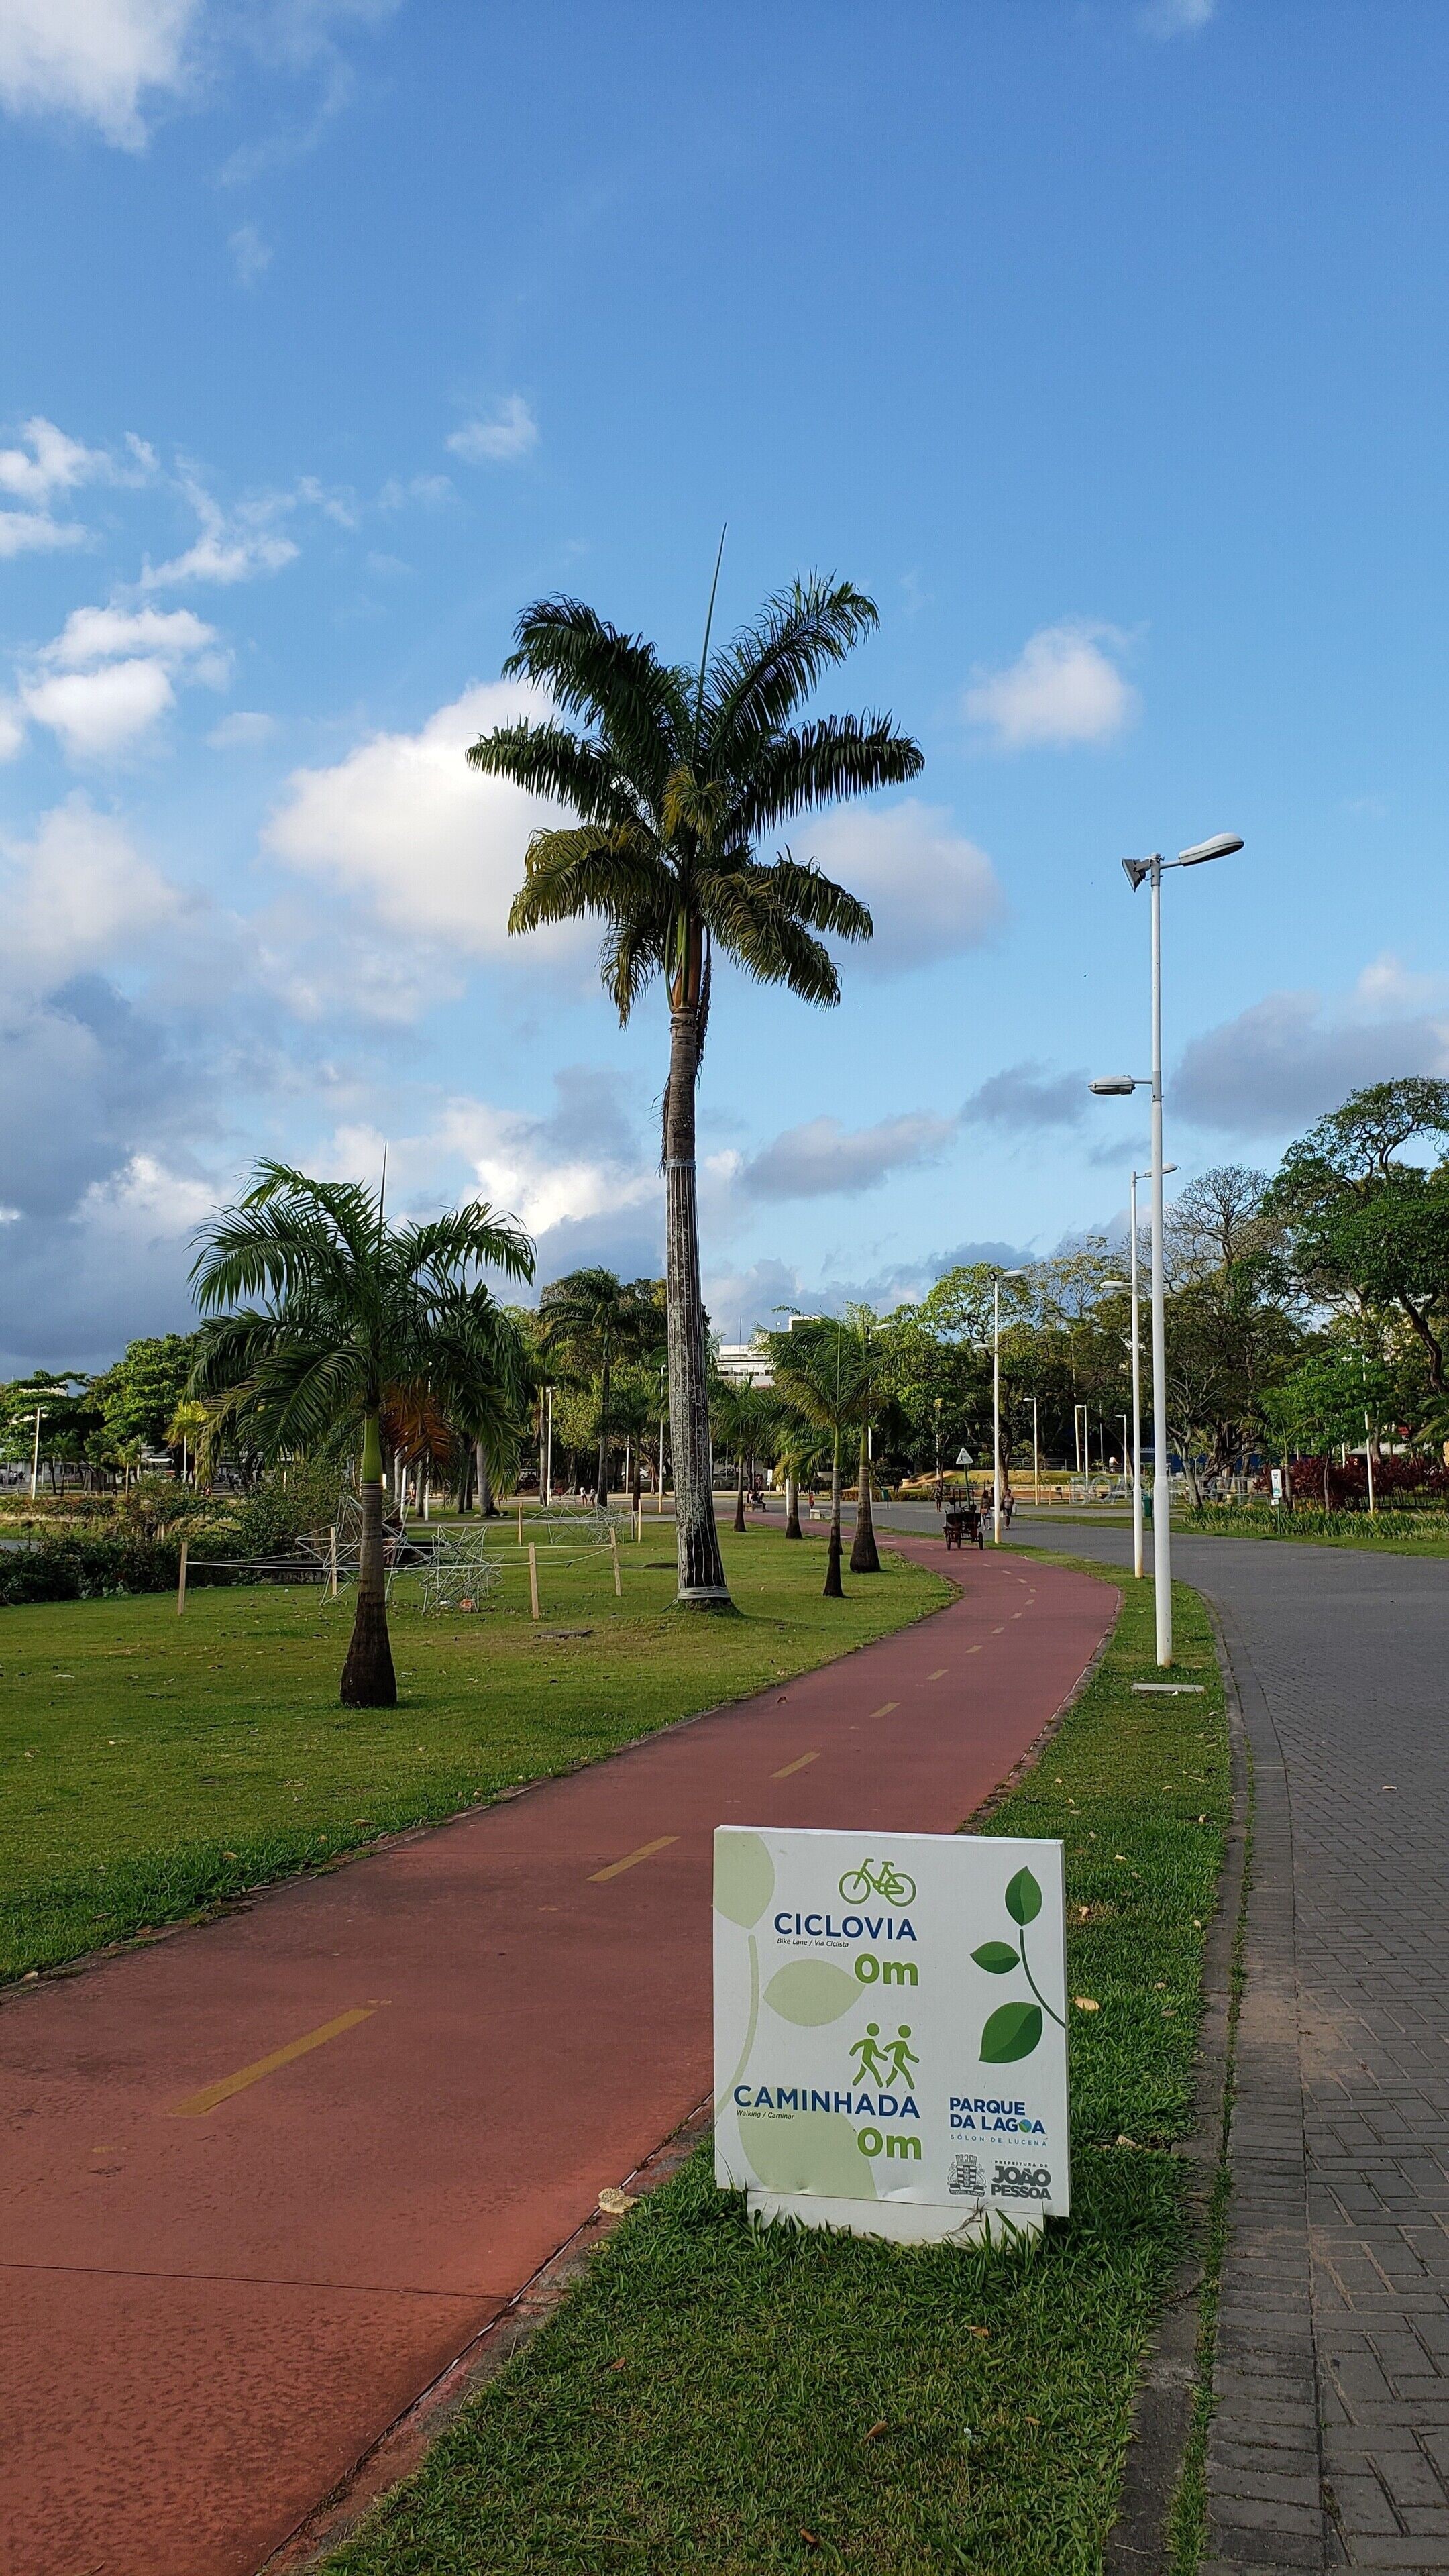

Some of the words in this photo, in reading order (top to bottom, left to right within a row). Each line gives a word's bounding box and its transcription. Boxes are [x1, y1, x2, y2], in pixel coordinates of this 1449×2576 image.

[774, 1912, 918, 1941] CICLOVIA
[777, 1937, 791, 1945] Bike
[792, 1938, 808, 1946] Lane
[826, 1940, 849, 1948] Ciclista
[854, 1953, 919, 1986] 0m
[733, 2084, 921, 2119] CAMINHADA
[949, 2096, 1026, 2116] PARQUE
[737, 2110, 761, 2119] Walking
[767, 2112, 795, 2121] Caminar
[950, 2114, 977, 2129] DA
[981, 2116, 1046, 2135] LAGOA
[857, 2127, 922, 2160] 0m
[1008, 2139, 1047, 2147] LUCENA
[991, 2165, 1052, 2188] JOÃO
[991, 2184, 1052, 2200] PESSOA
